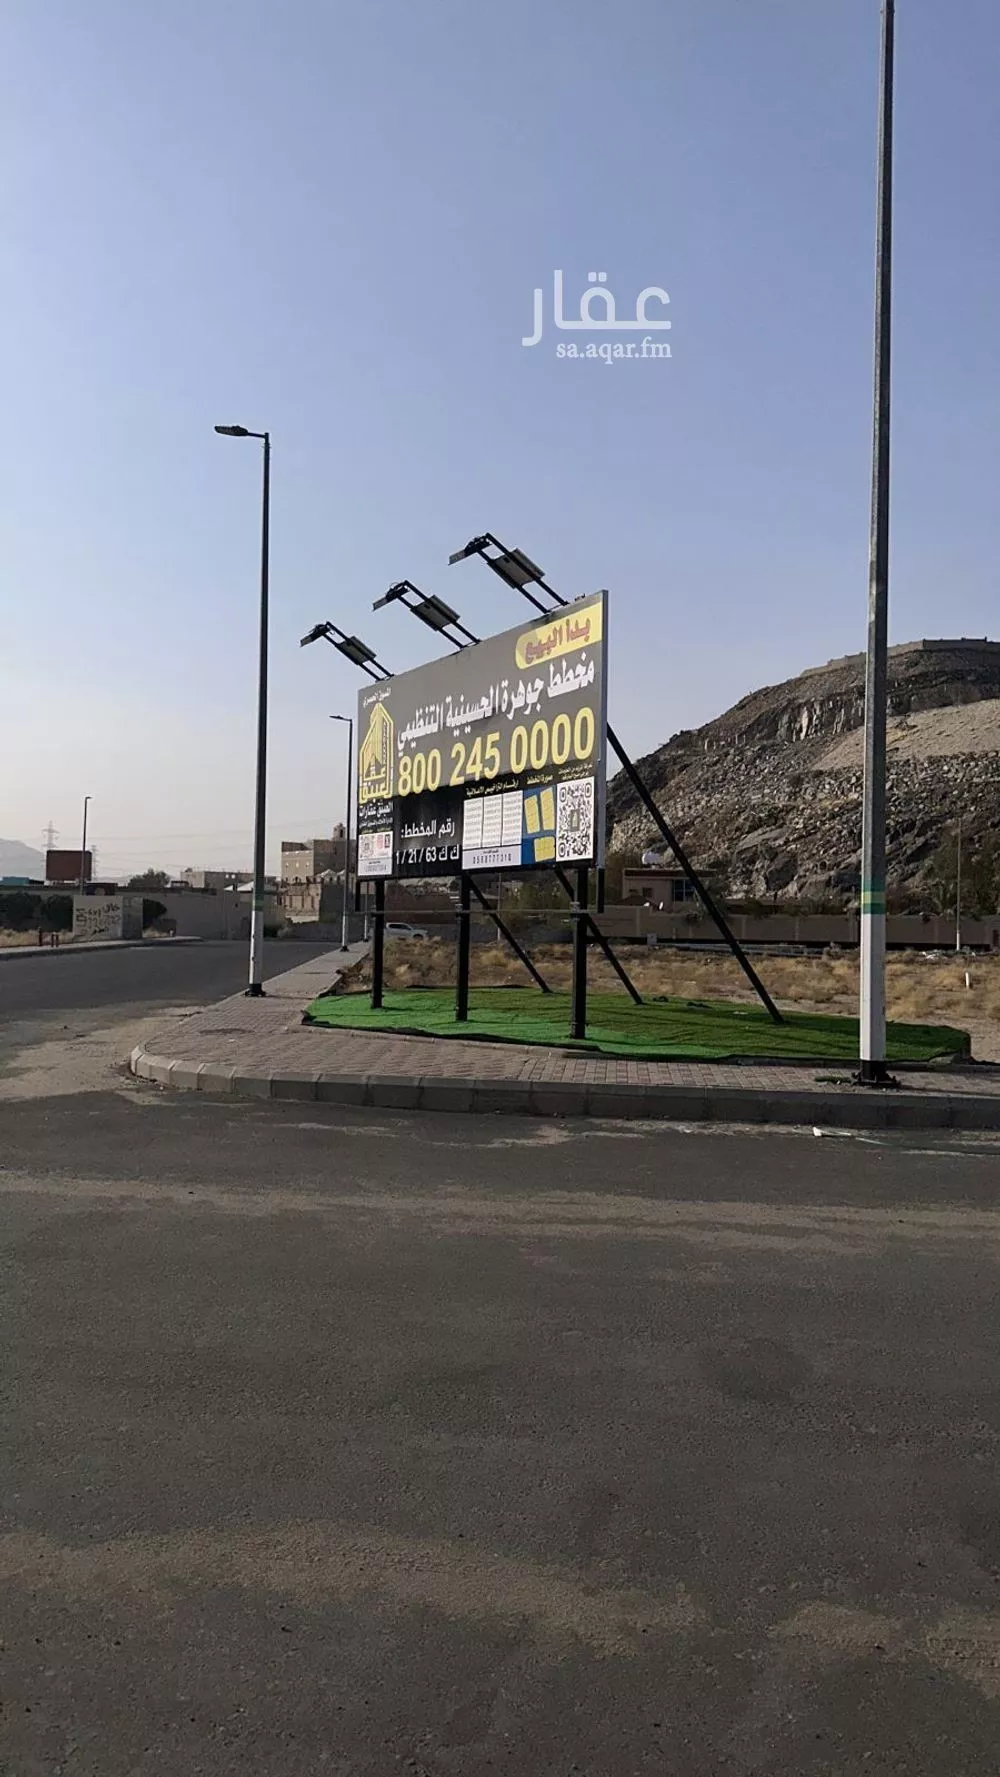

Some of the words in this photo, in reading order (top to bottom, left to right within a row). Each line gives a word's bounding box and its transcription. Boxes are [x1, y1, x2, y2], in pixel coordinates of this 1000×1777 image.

[525, 624, 563, 665] البيع
[547, 651, 595, 698] مخطط
[445, 684, 500, 737] الحسينية
[501, 678, 545, 720] جوهرة
[397, 701, 444, 757] التنظيمي
[398, 748, 441, 797] 800
[449, 731, 501, 787] 245
[510, 706, 595, 774] 0000
[401, 819, 437, 839] المخطط:
[438, 818, 455, 839] رقم
[408, 848, 418, 864] 21
[425, 846, 437, 863] 63
[439, 845, 448, 861] ك
[450, 843, 460, 860] ك
